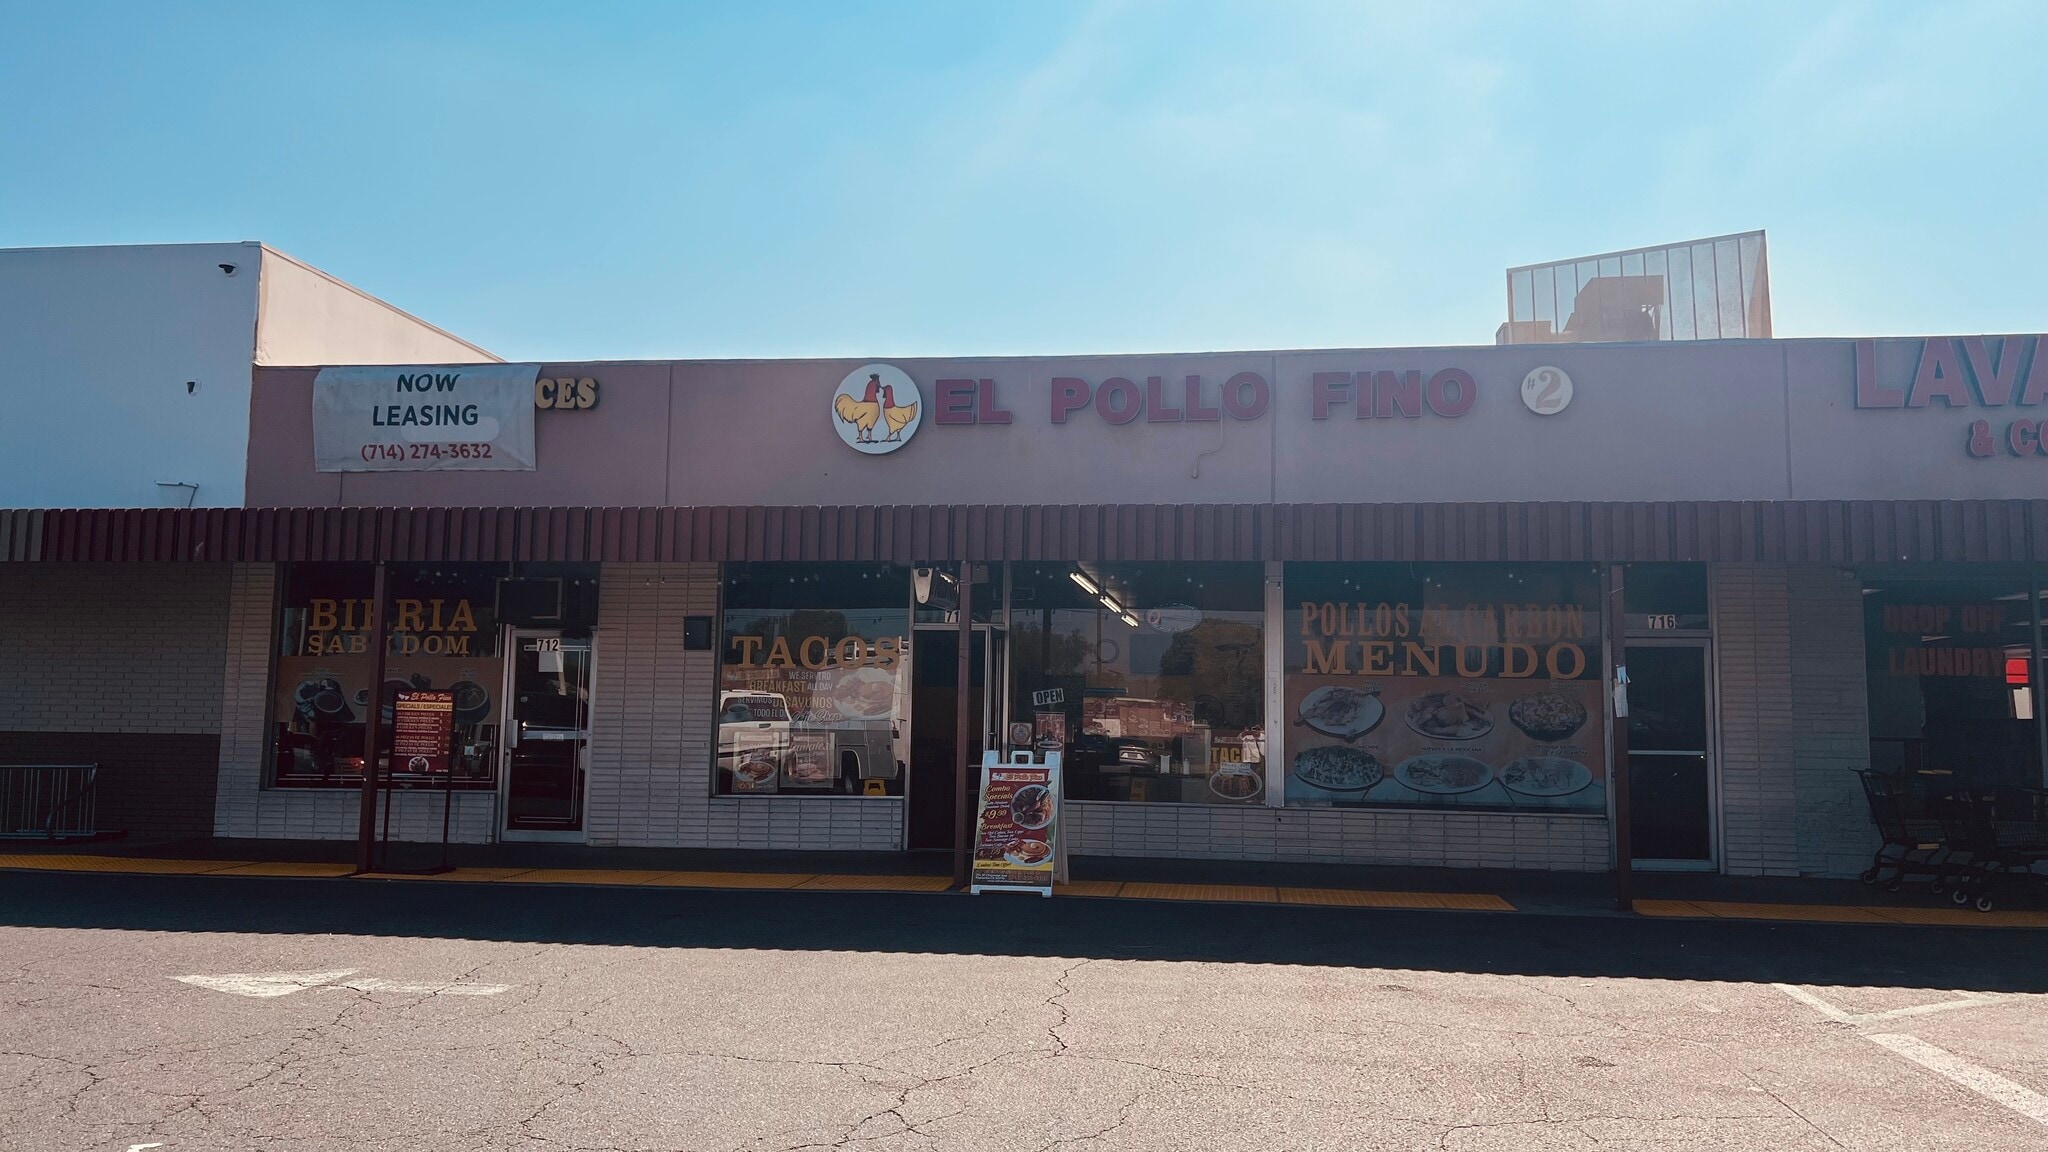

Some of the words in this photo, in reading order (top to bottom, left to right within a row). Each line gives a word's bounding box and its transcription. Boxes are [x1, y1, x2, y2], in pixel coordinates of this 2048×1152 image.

[396, 373, 461, 393] NOW
[934, 378, 1012, 425] EL
[1050, 371, 1270, 425] POLLO
[1311, 367, 1478, 420] FINO
[372, 404, 479, 427] LEASING
[1970, 419, 1997, 457] &
[361, 444, 405, 462] (714)
[409, 443, 493, 459] 274-3632
[1300, 602, 1410, 638] POLLOS
[1419, 602, 1450, 639] AL
[1463, 602, 1584, 640] CARBON
[1649, 615, 1674, 629] 716
[1884, 604, 1951, 634] DROP
[1961, 604, 2006, 634] OFF
[400, 635, 470, 656] DOM
[538, 639, 559, 651] 712
[731, 634, 900, 671] TACOS
[1302, 639, 1586, 680] MENUDO
[1888, 647, 2004, 677] LAUNDRY
[788, 671, 800, 680] WE
[749, 680, 807, 693] BREAKFAST
[807, 682, 818, 691] ALL
[819, 682, 833, 692] DAY
[1035, 688, 1064, 704] OPEN
[772, 696, 833, 709] DESAYUNOS
[754, 708, 771, 717] TODO
[984, 793, 1013, 802] Specials
[986, 785, 1011, 793] Combo
[981, 822, 1014, 830] Breakfast
